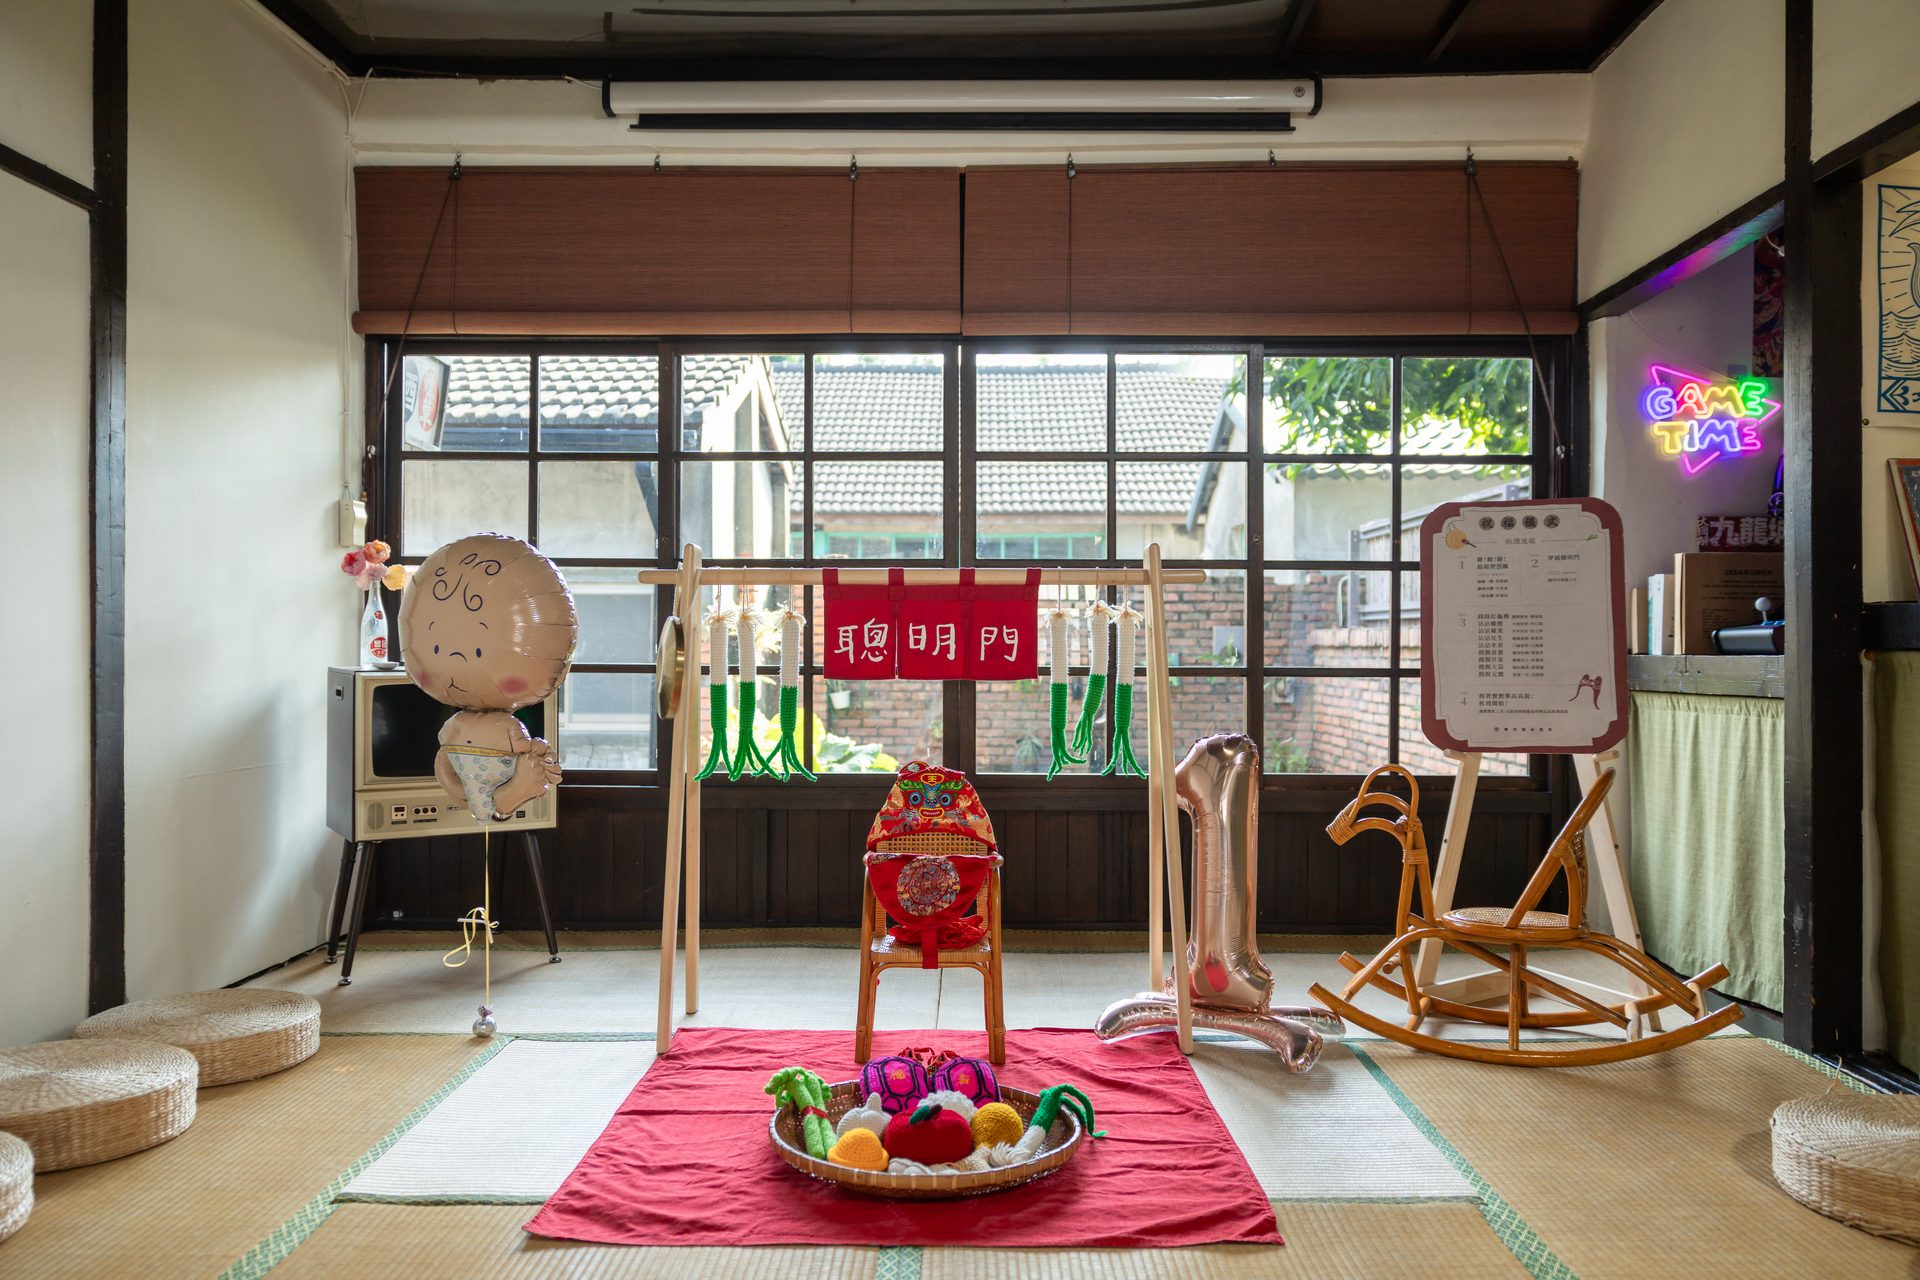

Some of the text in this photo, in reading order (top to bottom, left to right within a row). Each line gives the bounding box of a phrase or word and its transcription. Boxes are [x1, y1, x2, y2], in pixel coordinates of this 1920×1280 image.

[1647, 381, 1766, 420] GAME
[1653, 418, 1761, 454] TIME
[1531, 559, 1540, 568] 2
[1460, 617, 1467, 627] 3
[834, 618, 1019, 664] 聰明門
[1460, 697, 1468, 706] 4
